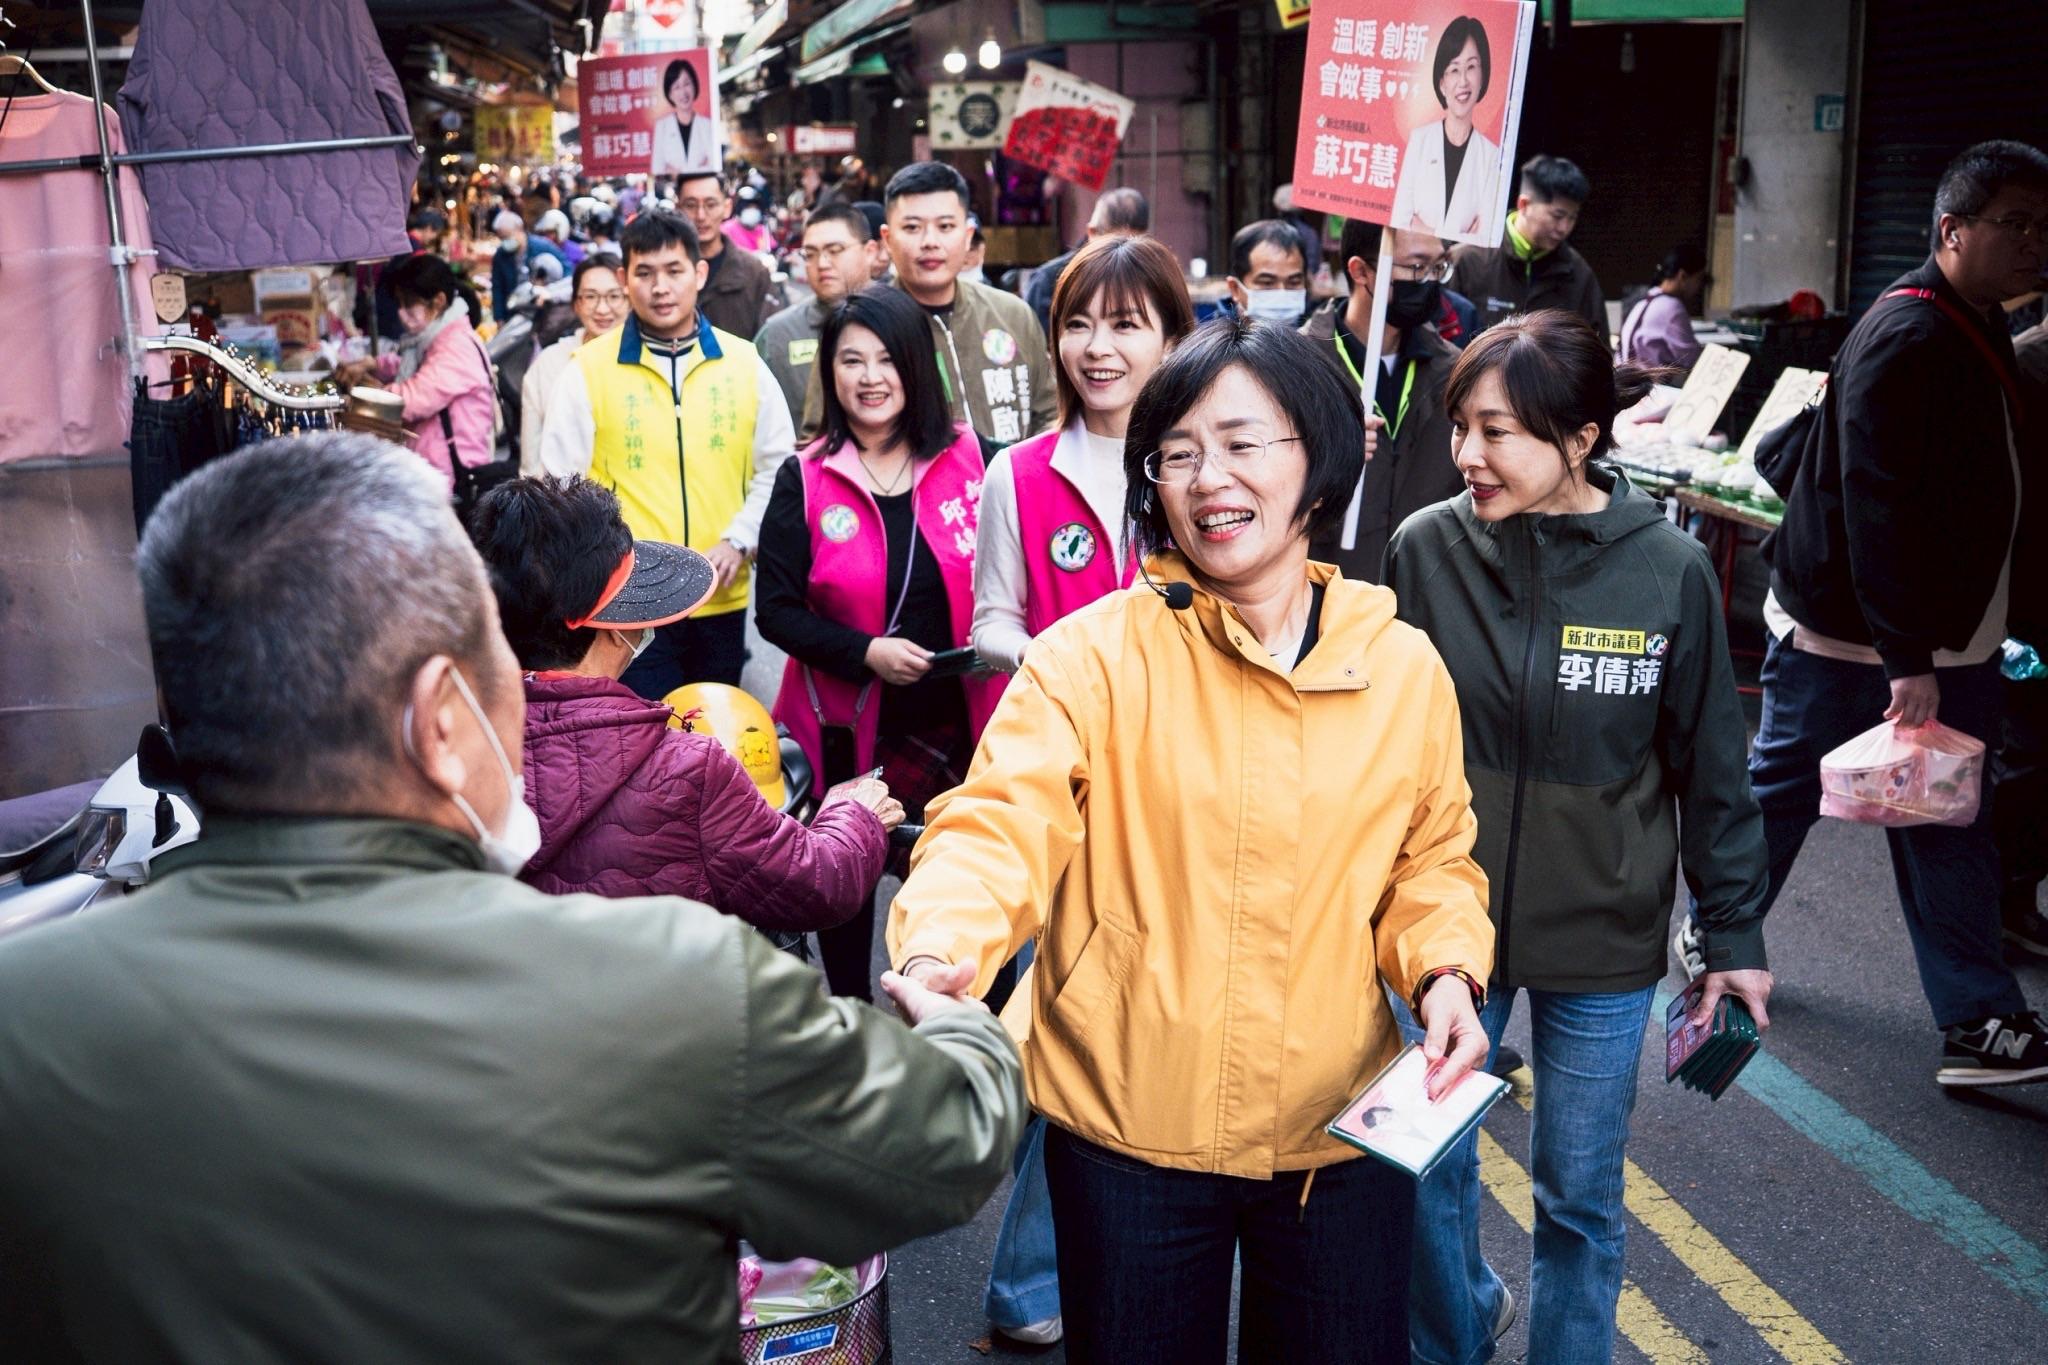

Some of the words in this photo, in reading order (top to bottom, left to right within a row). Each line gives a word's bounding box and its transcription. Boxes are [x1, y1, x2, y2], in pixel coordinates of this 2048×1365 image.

[1332, 17, 1378, 58] 溫暖
[1381, 21, 1430, 64] 創新
[1320, 59, 1384, 104] 會做事
[1312, 134, 1399, 189] 蘇巧慧
[1567, 630, 1641, 650] 新北市議員
[1558, 654, 1662, 695] 李倩萍
